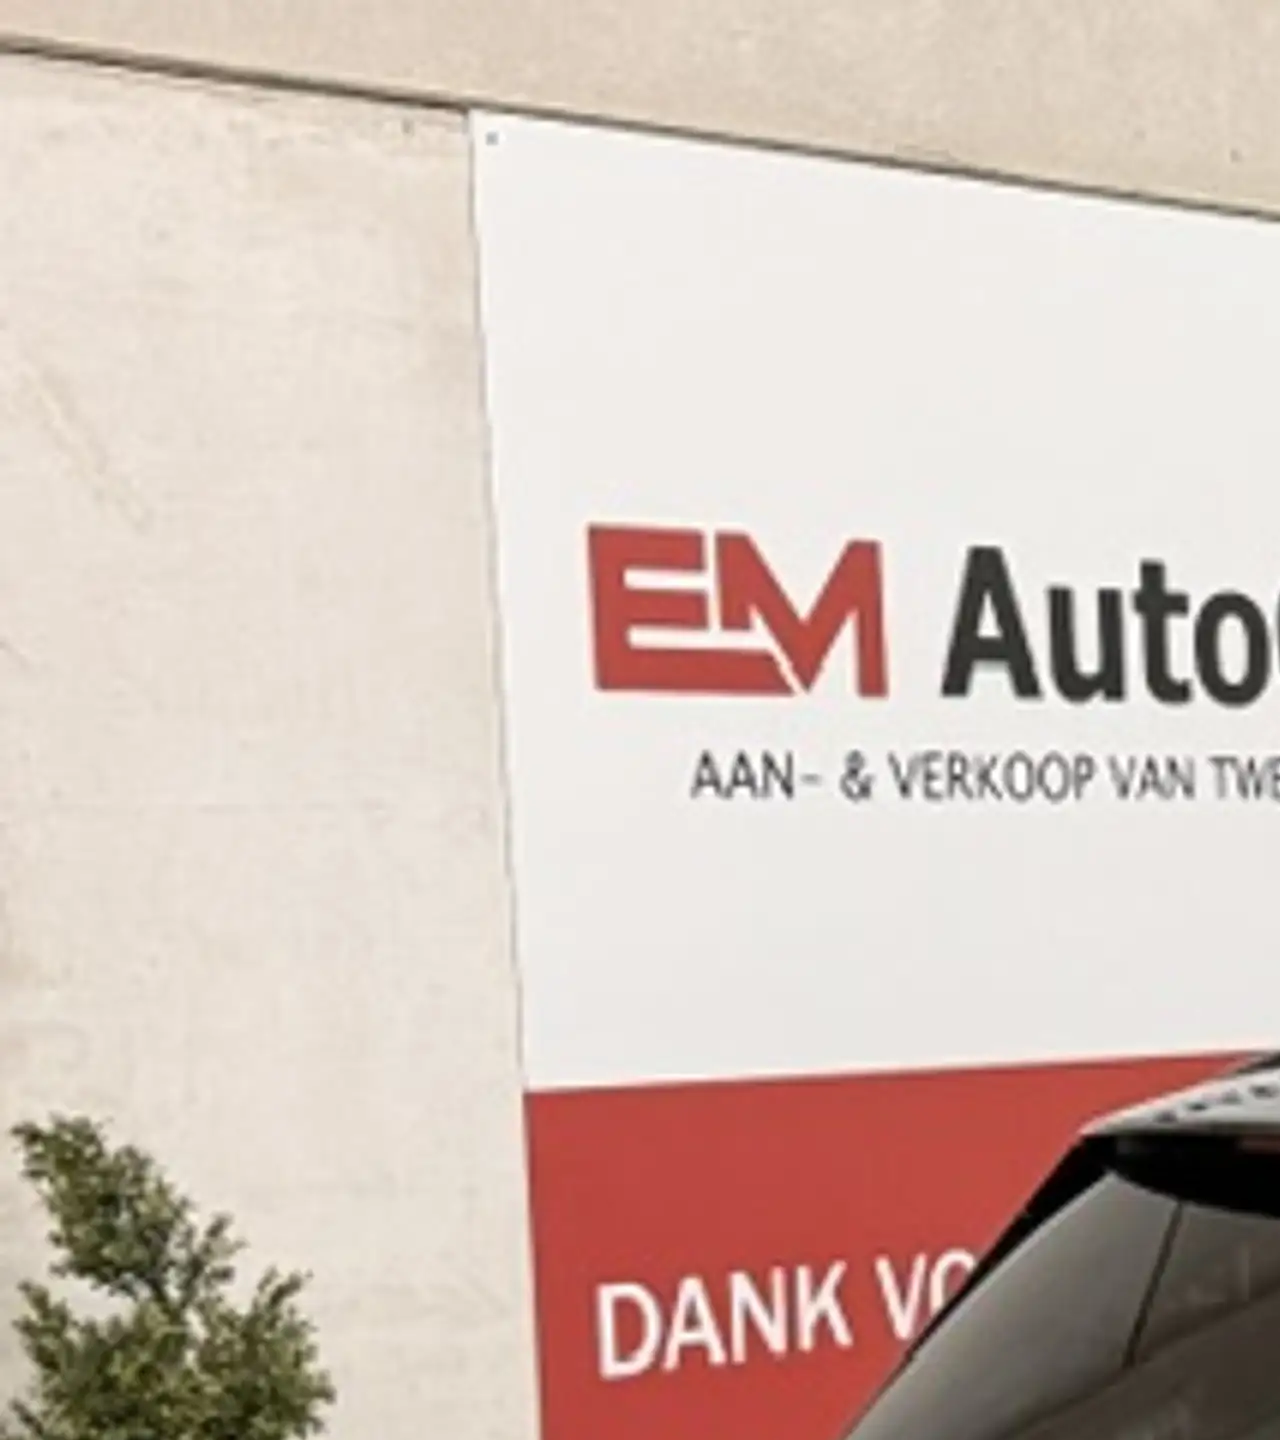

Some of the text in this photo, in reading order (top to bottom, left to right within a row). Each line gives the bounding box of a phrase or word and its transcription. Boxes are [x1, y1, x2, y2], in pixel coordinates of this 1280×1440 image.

[587, 522, 888, 699] EM
[839, 749, 873, 803] &
[887, 750, 1095, 803] VERKOOP
[1107, 755, 1196, 802] VAN
[597, 1260, 853, 1381] DANK
